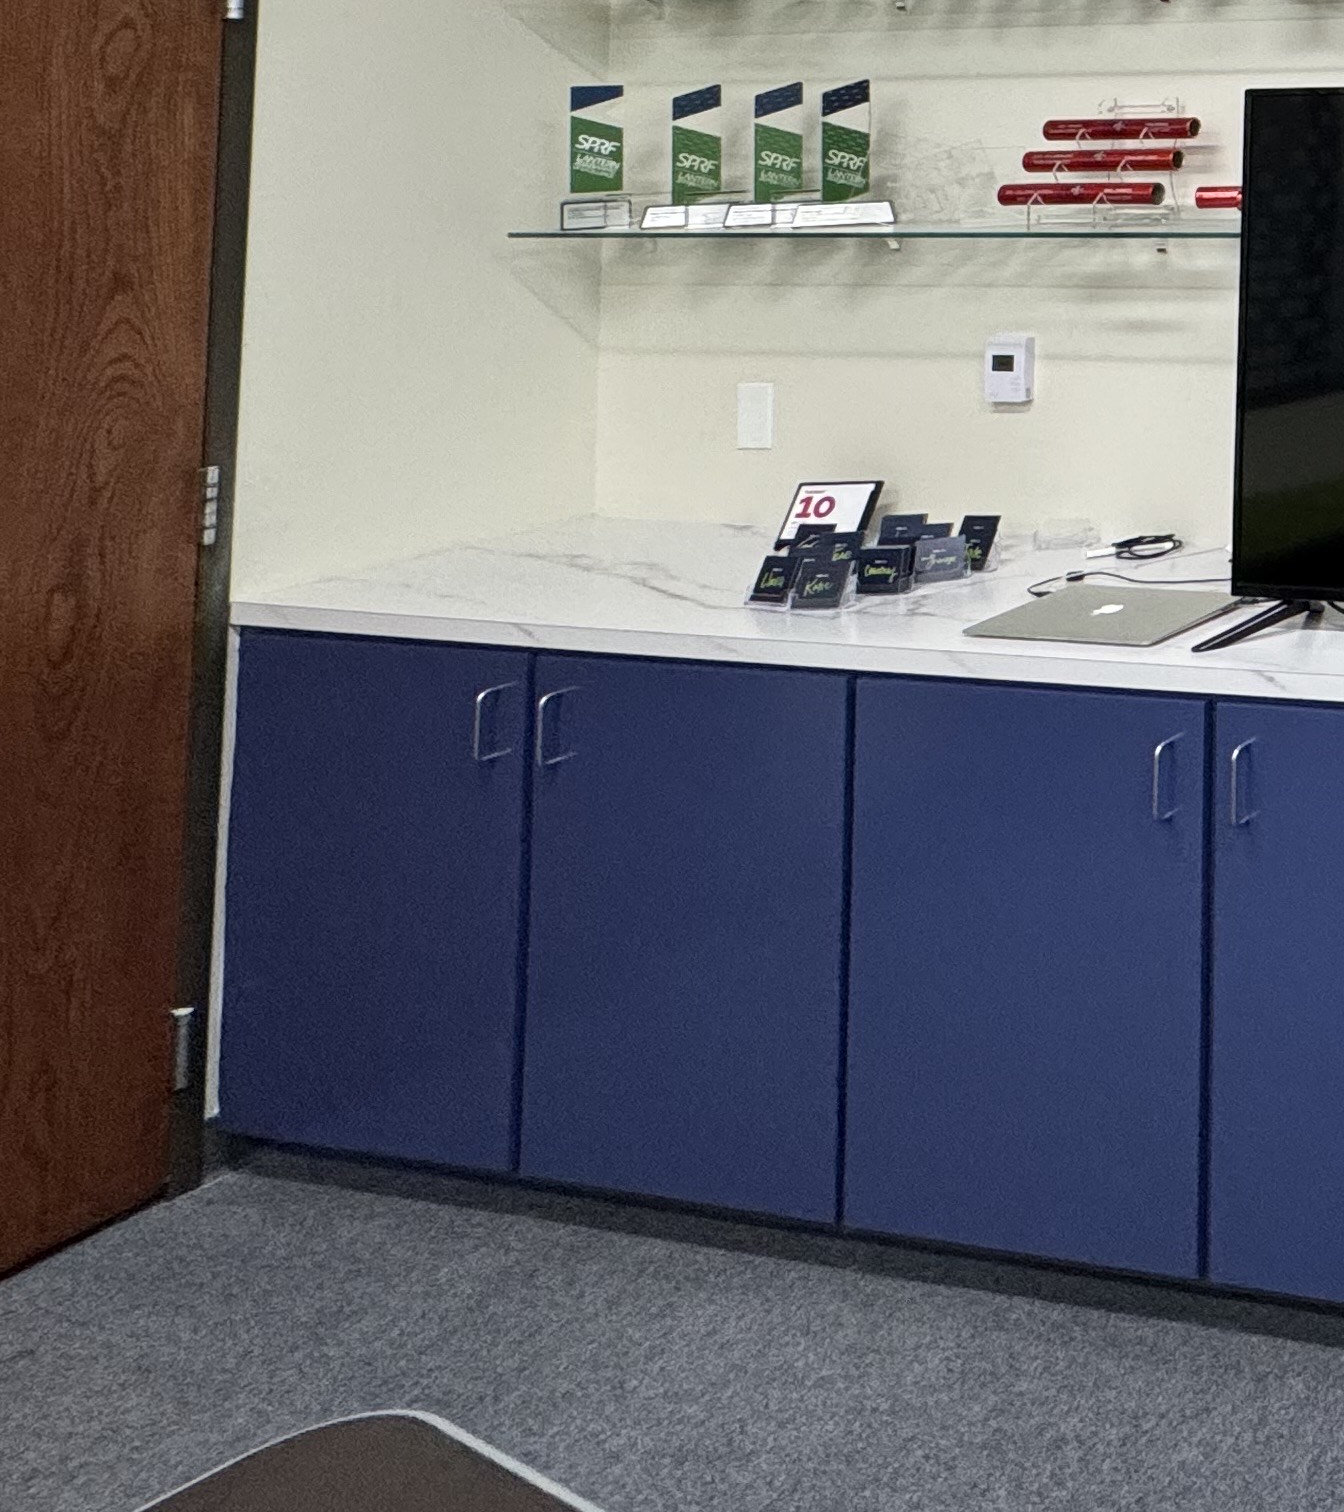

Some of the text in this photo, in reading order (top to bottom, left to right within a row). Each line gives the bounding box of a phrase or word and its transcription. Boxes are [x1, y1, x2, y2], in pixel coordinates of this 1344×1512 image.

[575, 134, 621, 156] SPRF
[676, 152, 719, 174] SPRF
[758, 150, 801, 171] SPRF
[824, 149, 868, 171] SPRF
[794, 496, 836, 519] 10
